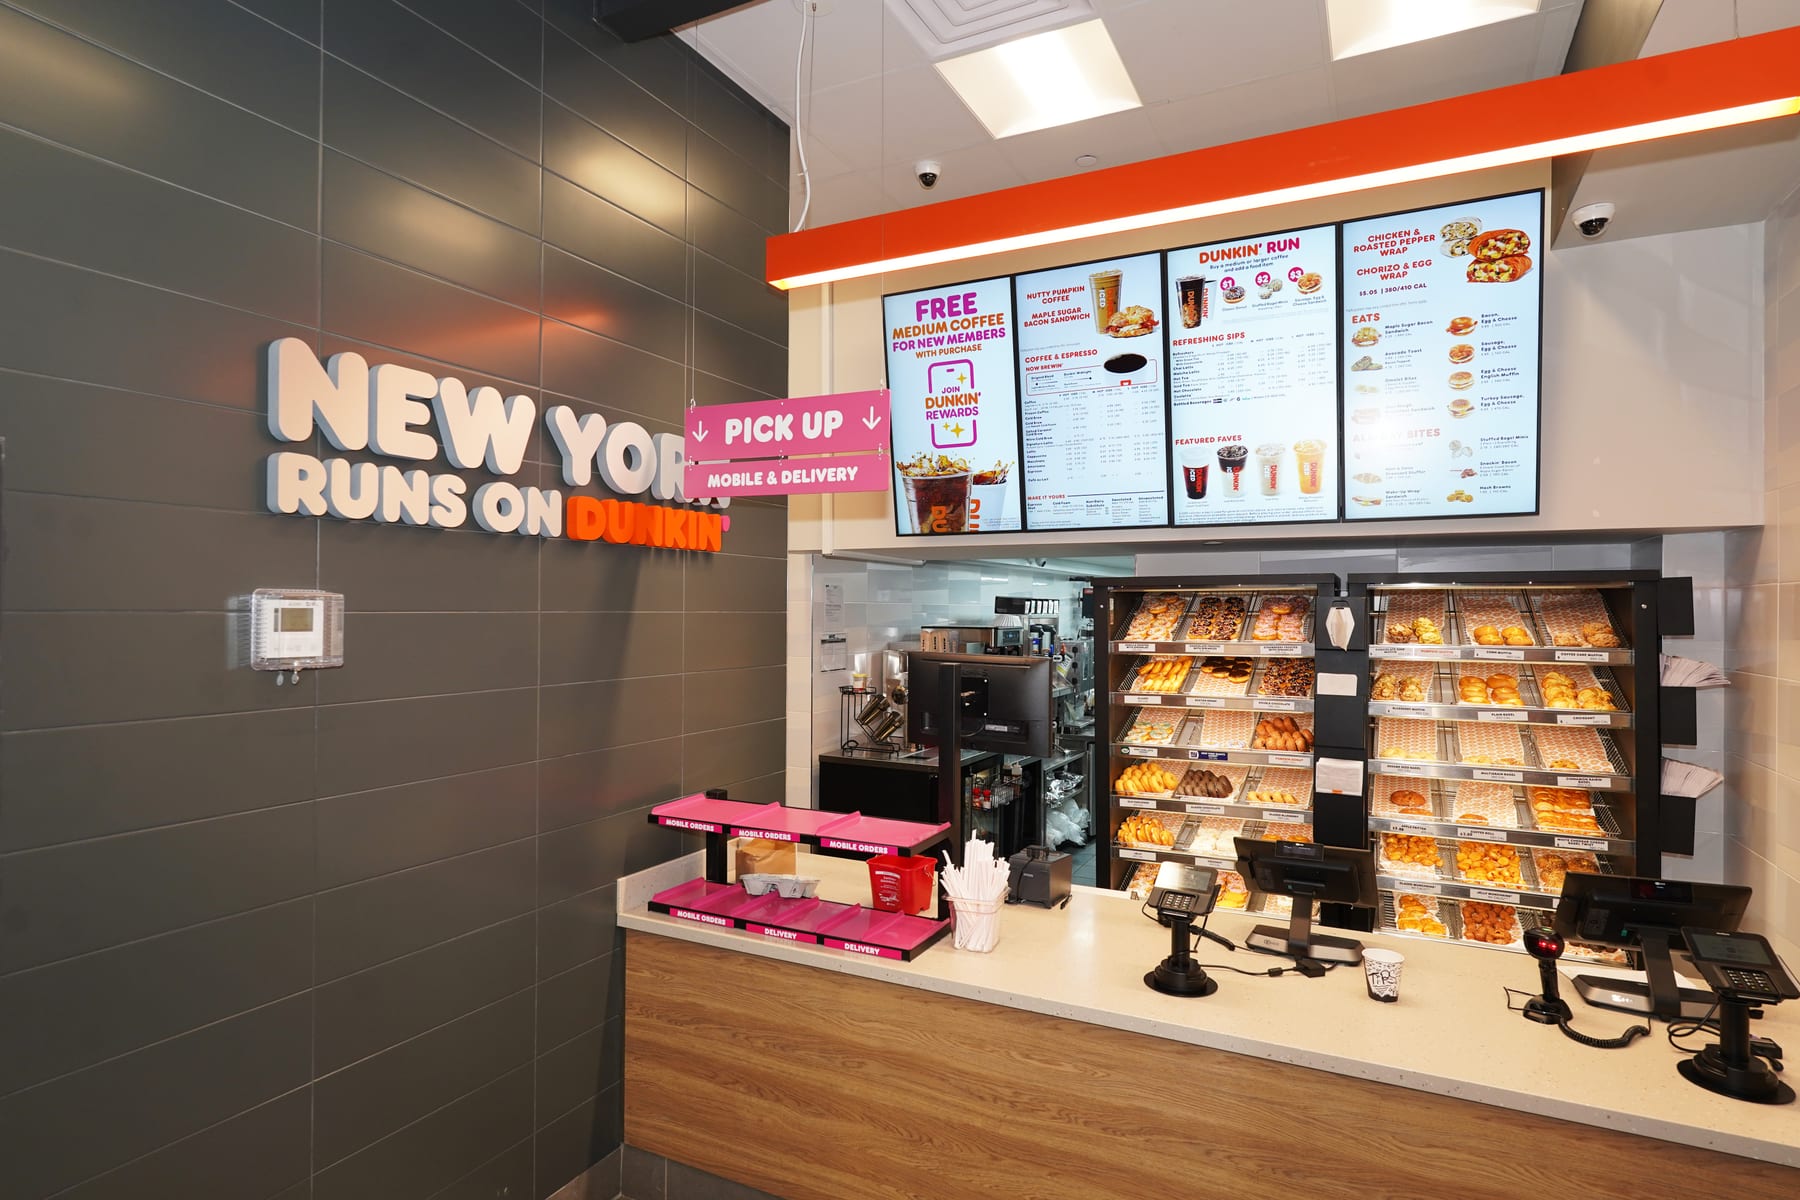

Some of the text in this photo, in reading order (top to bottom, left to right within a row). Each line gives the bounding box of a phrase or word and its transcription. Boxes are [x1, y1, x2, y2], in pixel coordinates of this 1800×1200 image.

[1368, 230, 1410, 242] CHICKEN
[1199, 236, 1300, 264] DUNKIN' RUN
[1353, 234, 1436, 253] ROASTED PEPPER
[1380, 246, 1408, 256] WRAP
[1290, 270, 1302, 279] $3
[1356, 264, 1400, 276] CHORIZO
[1412, 259, 1432, 269] EGG
[1256, 274, 1269, 283] $2
[1380, 271, 1408, 281] WRAP
[1222, 280, 1230, 288] $1
[1026, 286, 1085, 300] NUTTY PUMPKIN
[1042, 295, 1070, 304] COFFEE
[916, 292, 978, 322] FREE
[1032, 306, 1082, 320] MAPLE SUGAR
[1024, 313, 1090, 327] BACON SANDWICH
[1351, 313, 1380, 324] EATS
[892, 312, 1004, 340] MEDIUM COFFEE
[892, 327, 1006, 353] FOR NEW MEMBERS
[1172, 335, 1224, 347] REFRESHING
[915, 344, 982, 359] WITH PURCHASE
[1025, 354, 1052, 364] COFFEE
[1061, 349, 1098, 359] ESPRESSO
[942, 386, 960, 394] JOIN
[268, 337, 536, 475] NEW
[925, 392, 982, 410] DUNKIN'
[926, 406, 979, 421] REWARDS
[725, 410, 844, 445] PICK UP
[1407, 428, 1440, 438] BITES
[1175, 434, 1242, 446] FEATURED FAVES
[708, 466, 858, 488] MOBILE & DELIVERY
[267, 452, 467, 529] RUNS
[472, 482, 562, 538] ON
[666, 818, 714, 833] MOBILE ORDERS
[739, 829, 792, 841] MOBILE ORDERS
[830, 840, 888, 855] MOBILE ORDERS
[677, 910, 726, 926] MOBILE ORDERS
[764, 928, 797, 940] DELIVERY
[844, 942, 880, 956] DELIVERY
